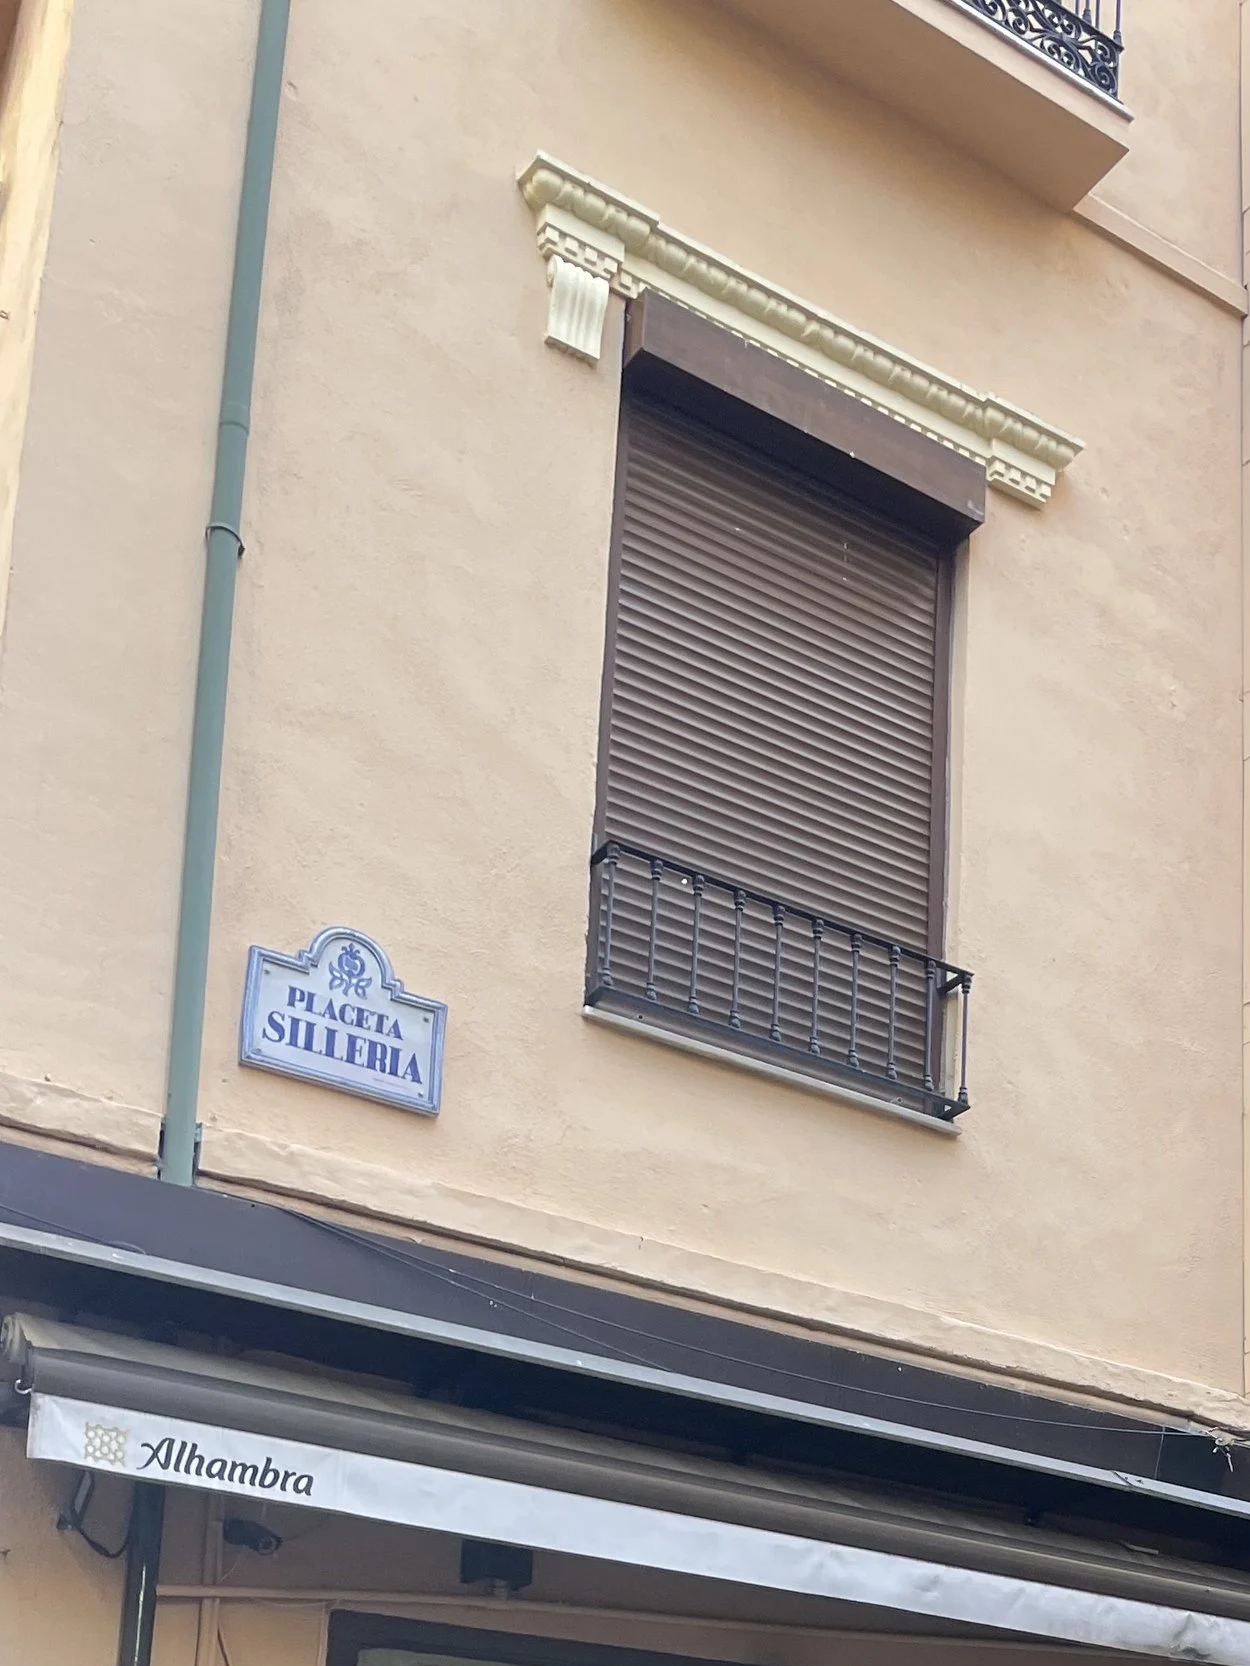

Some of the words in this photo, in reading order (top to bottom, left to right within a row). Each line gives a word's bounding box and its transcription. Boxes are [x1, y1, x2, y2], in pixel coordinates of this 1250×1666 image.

[286, 984, 403, 1041] PLACETA
[261, 1010, 423, 1085] SILLERIA
[136, 1437, 314, 1497] Alhambra
